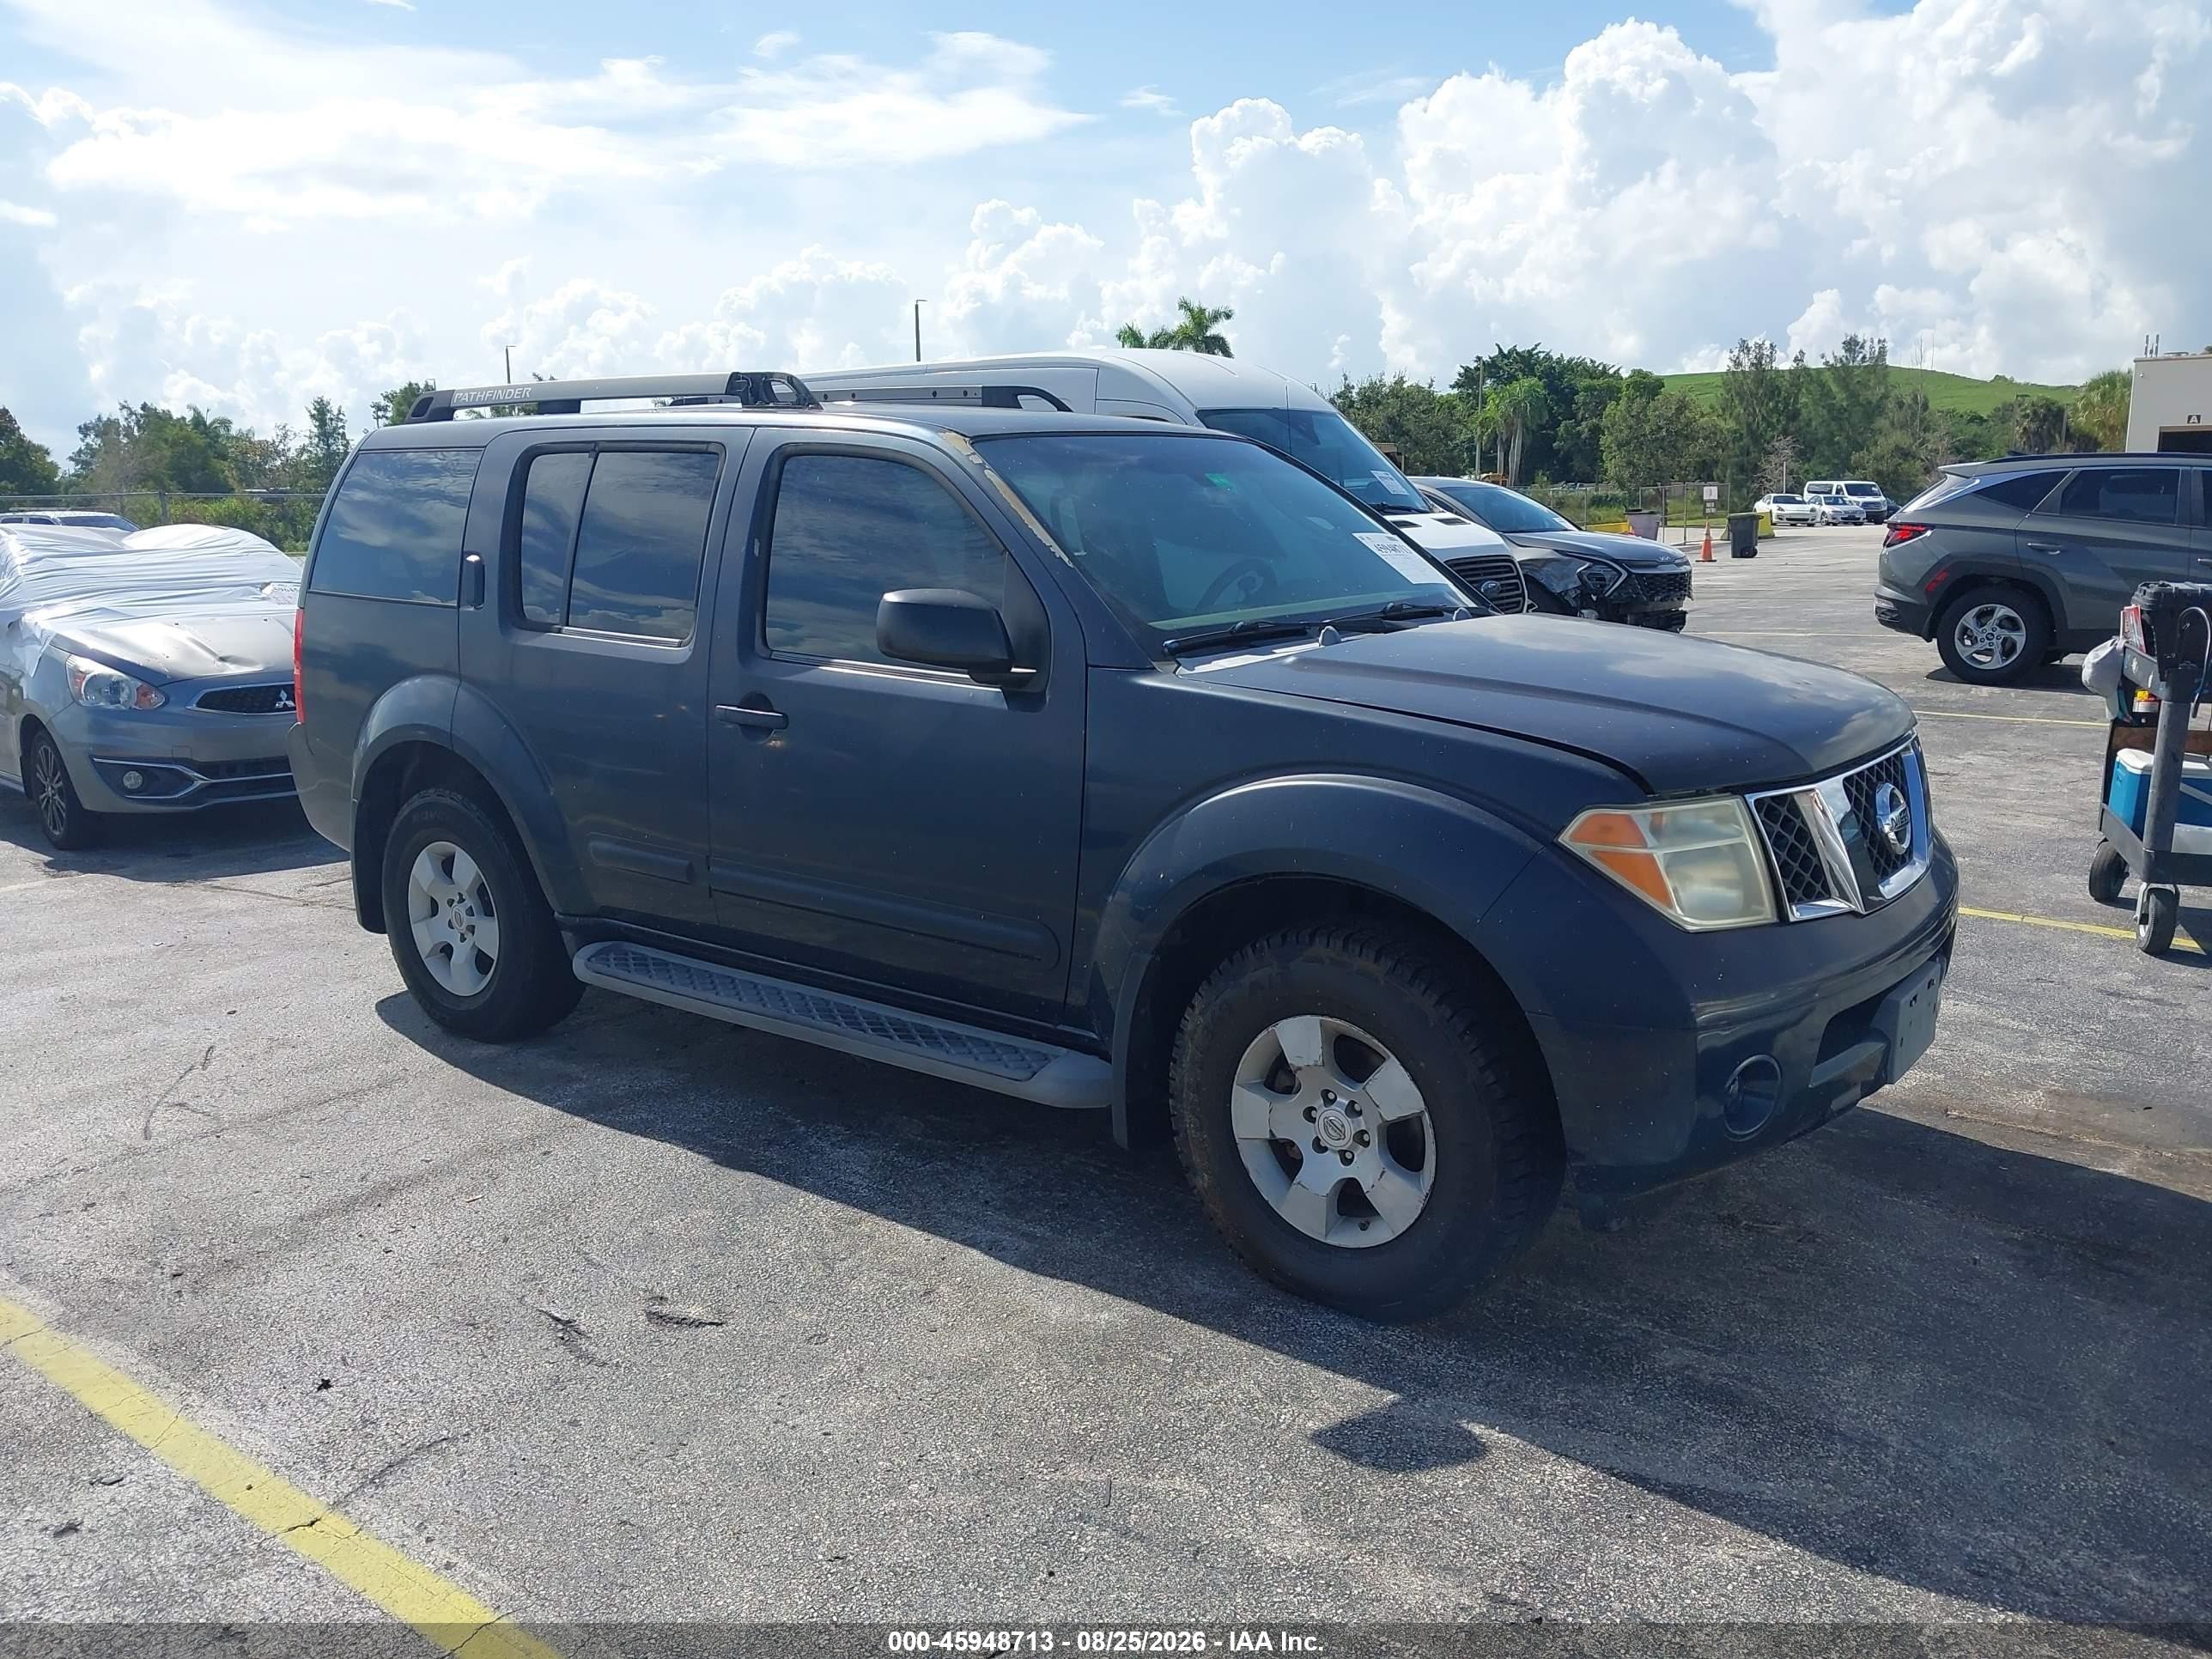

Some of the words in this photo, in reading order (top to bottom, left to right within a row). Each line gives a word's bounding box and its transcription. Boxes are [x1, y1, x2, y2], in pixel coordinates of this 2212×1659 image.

[453, 387, 532, 404] PATHFINDER
[2190, 415, 2199, 423] A
[1890, 808, 1910, 830] NISS
